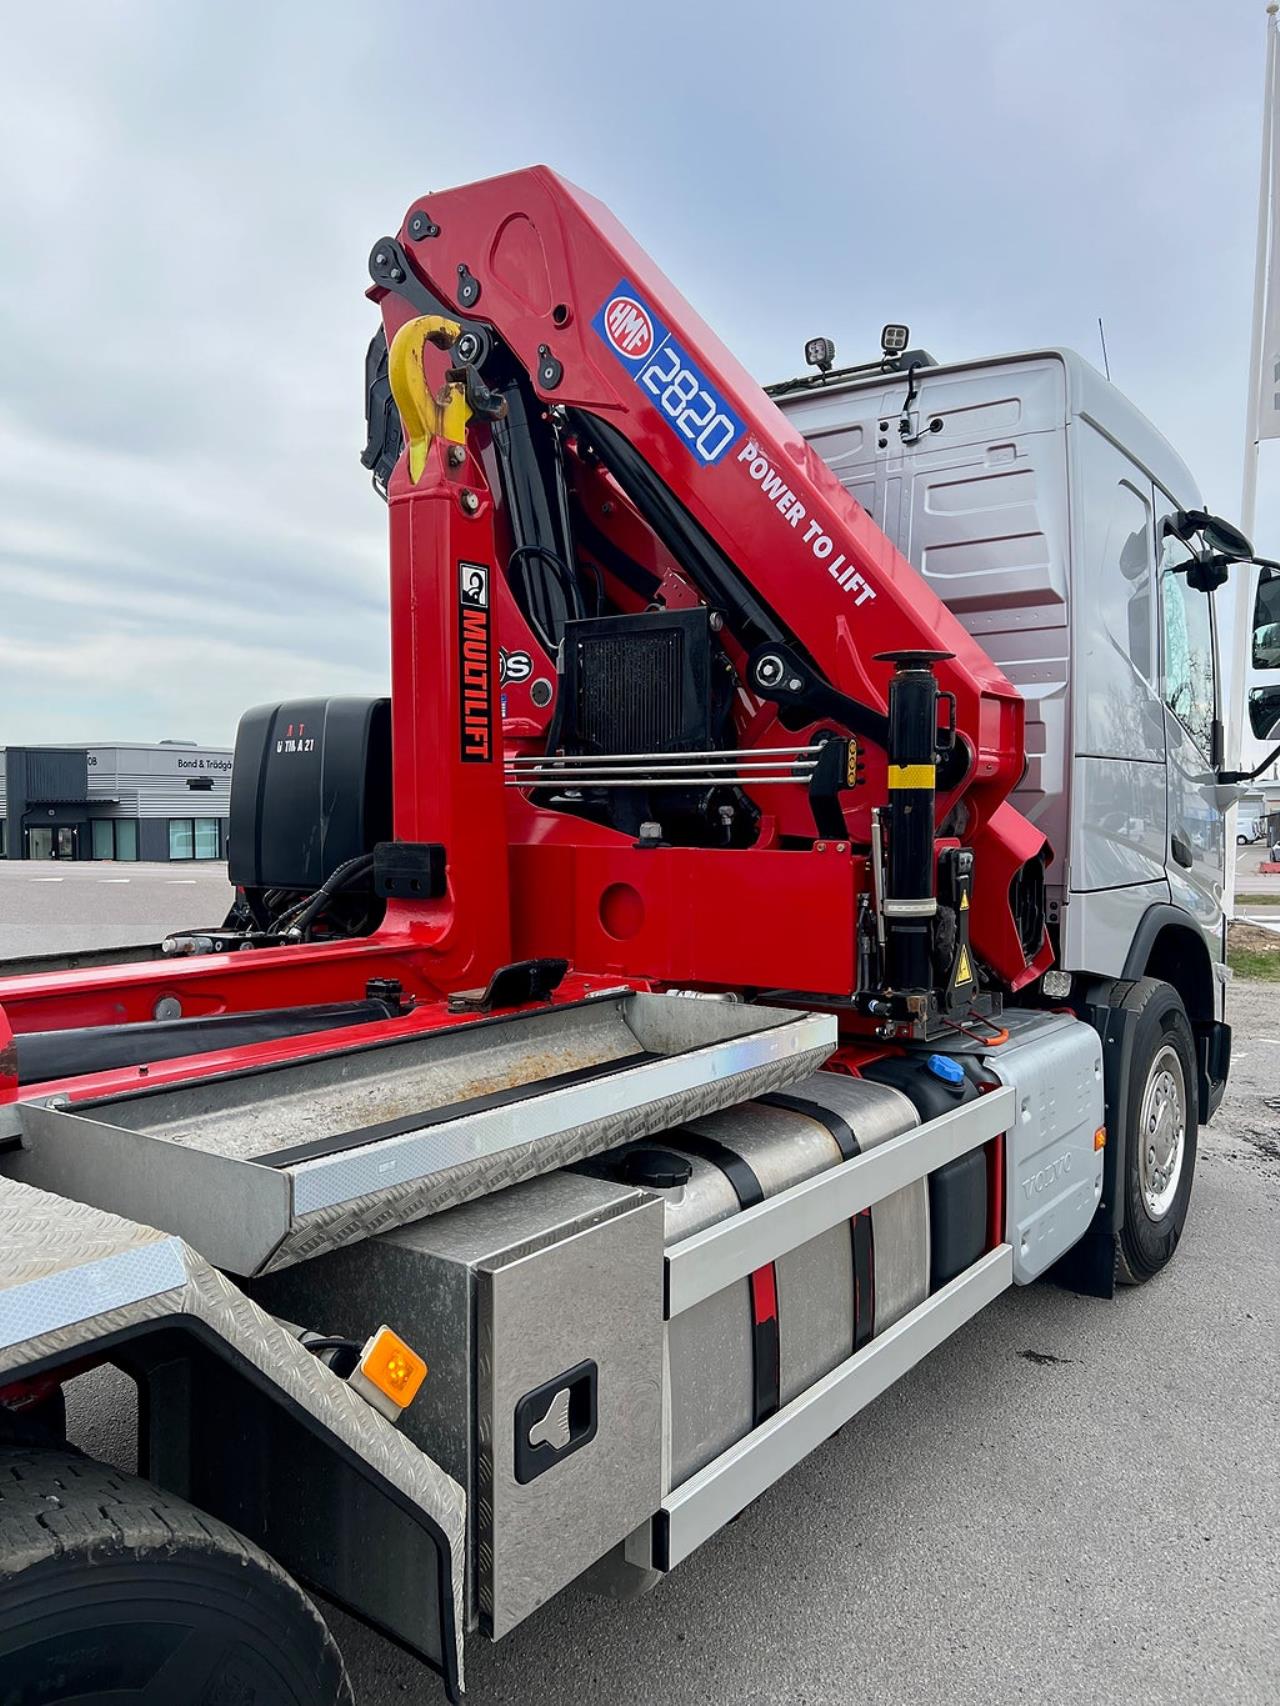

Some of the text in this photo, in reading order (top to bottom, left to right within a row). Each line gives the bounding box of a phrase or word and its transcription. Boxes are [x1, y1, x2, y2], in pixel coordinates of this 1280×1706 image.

[609, 302, 649, 351] HMF
[641, 347, 735, 461] 2820
[737, 441, 877, 607] POWER TO LIFT
[463, 609, 488, 759] MULTILIFT
[178, 759, 197, 768] Bond
[198, 759, 205, 768] &
[1022, 1151, 1072, 1200] VOLVO
